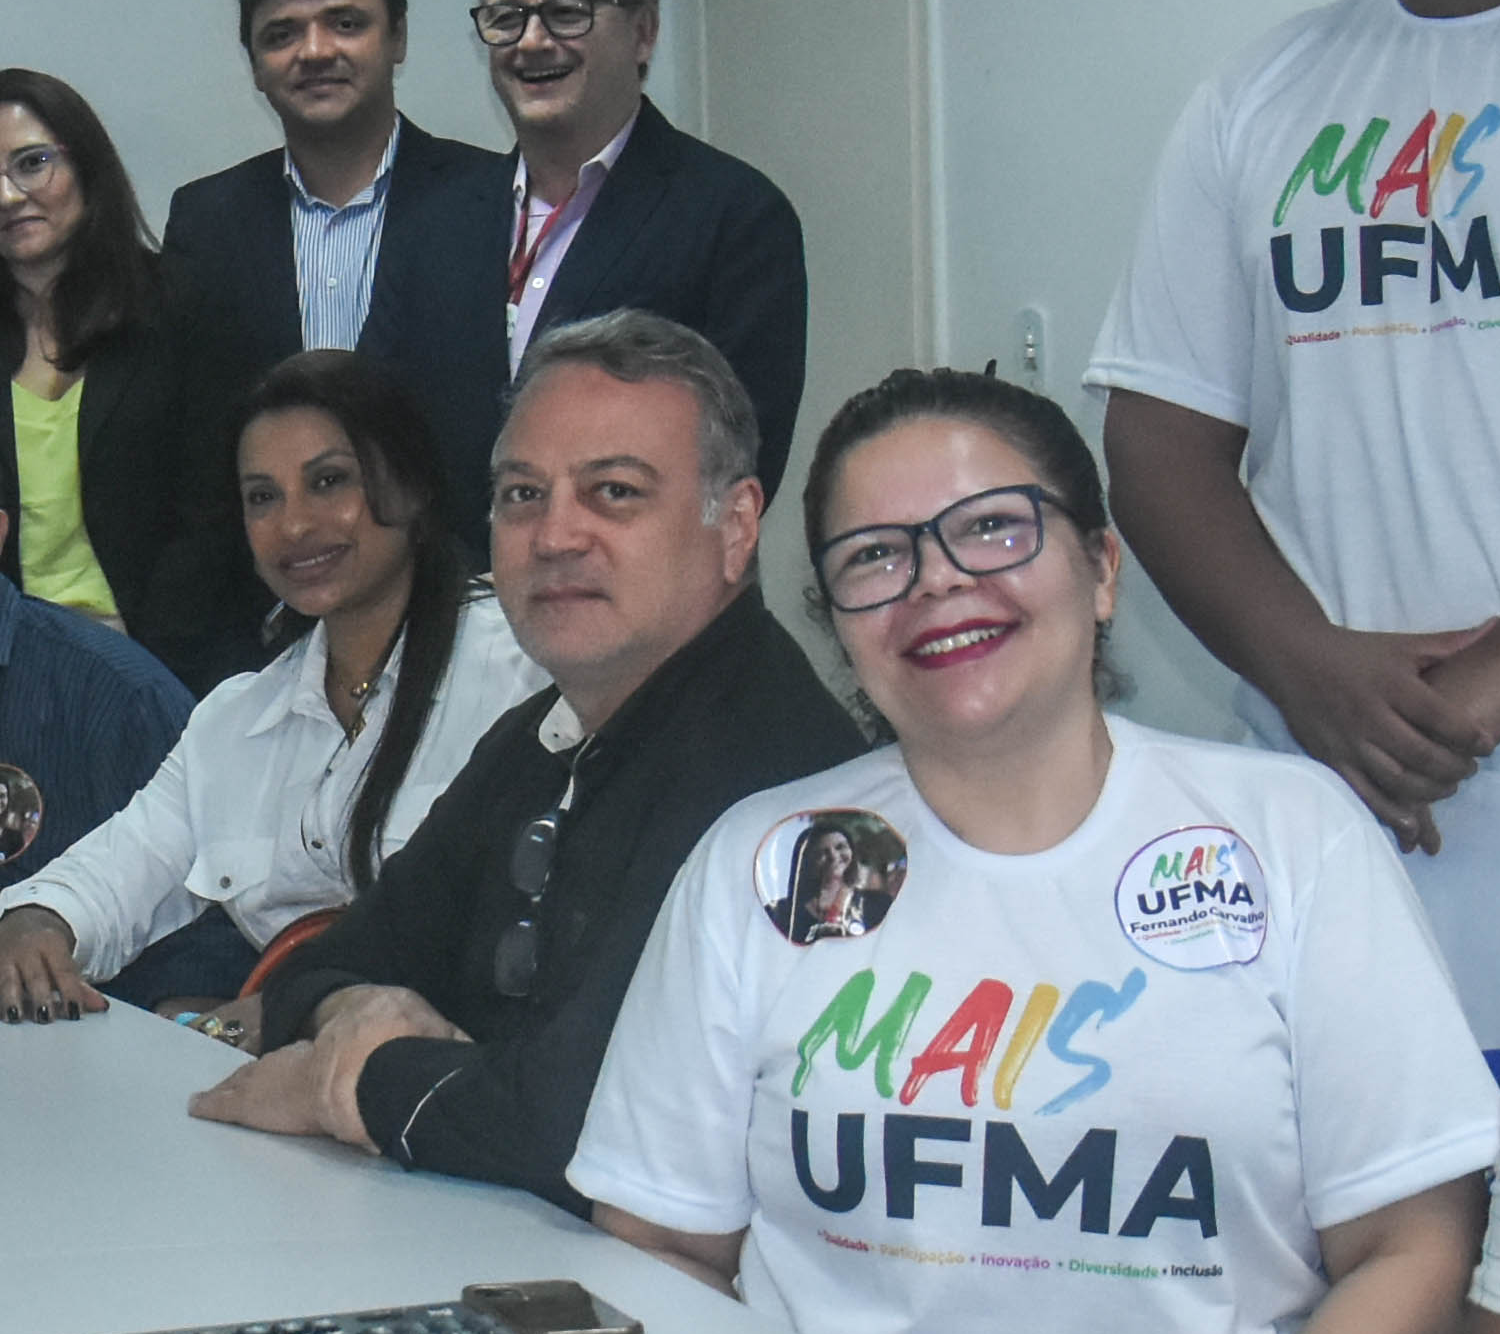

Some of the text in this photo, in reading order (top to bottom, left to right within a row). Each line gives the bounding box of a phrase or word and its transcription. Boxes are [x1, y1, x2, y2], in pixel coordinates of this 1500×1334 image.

[1150, 840, 1237, 888] MAIS
[1130, 909, 1208, 934] Fernando
[1209, 906, 1265, 925] Carvalho
[1137, 879, 1254, 915] UFMA
[790, 967, 1147, 1116] MAIS
[791, 1108, 1218, 1240] UFMA
